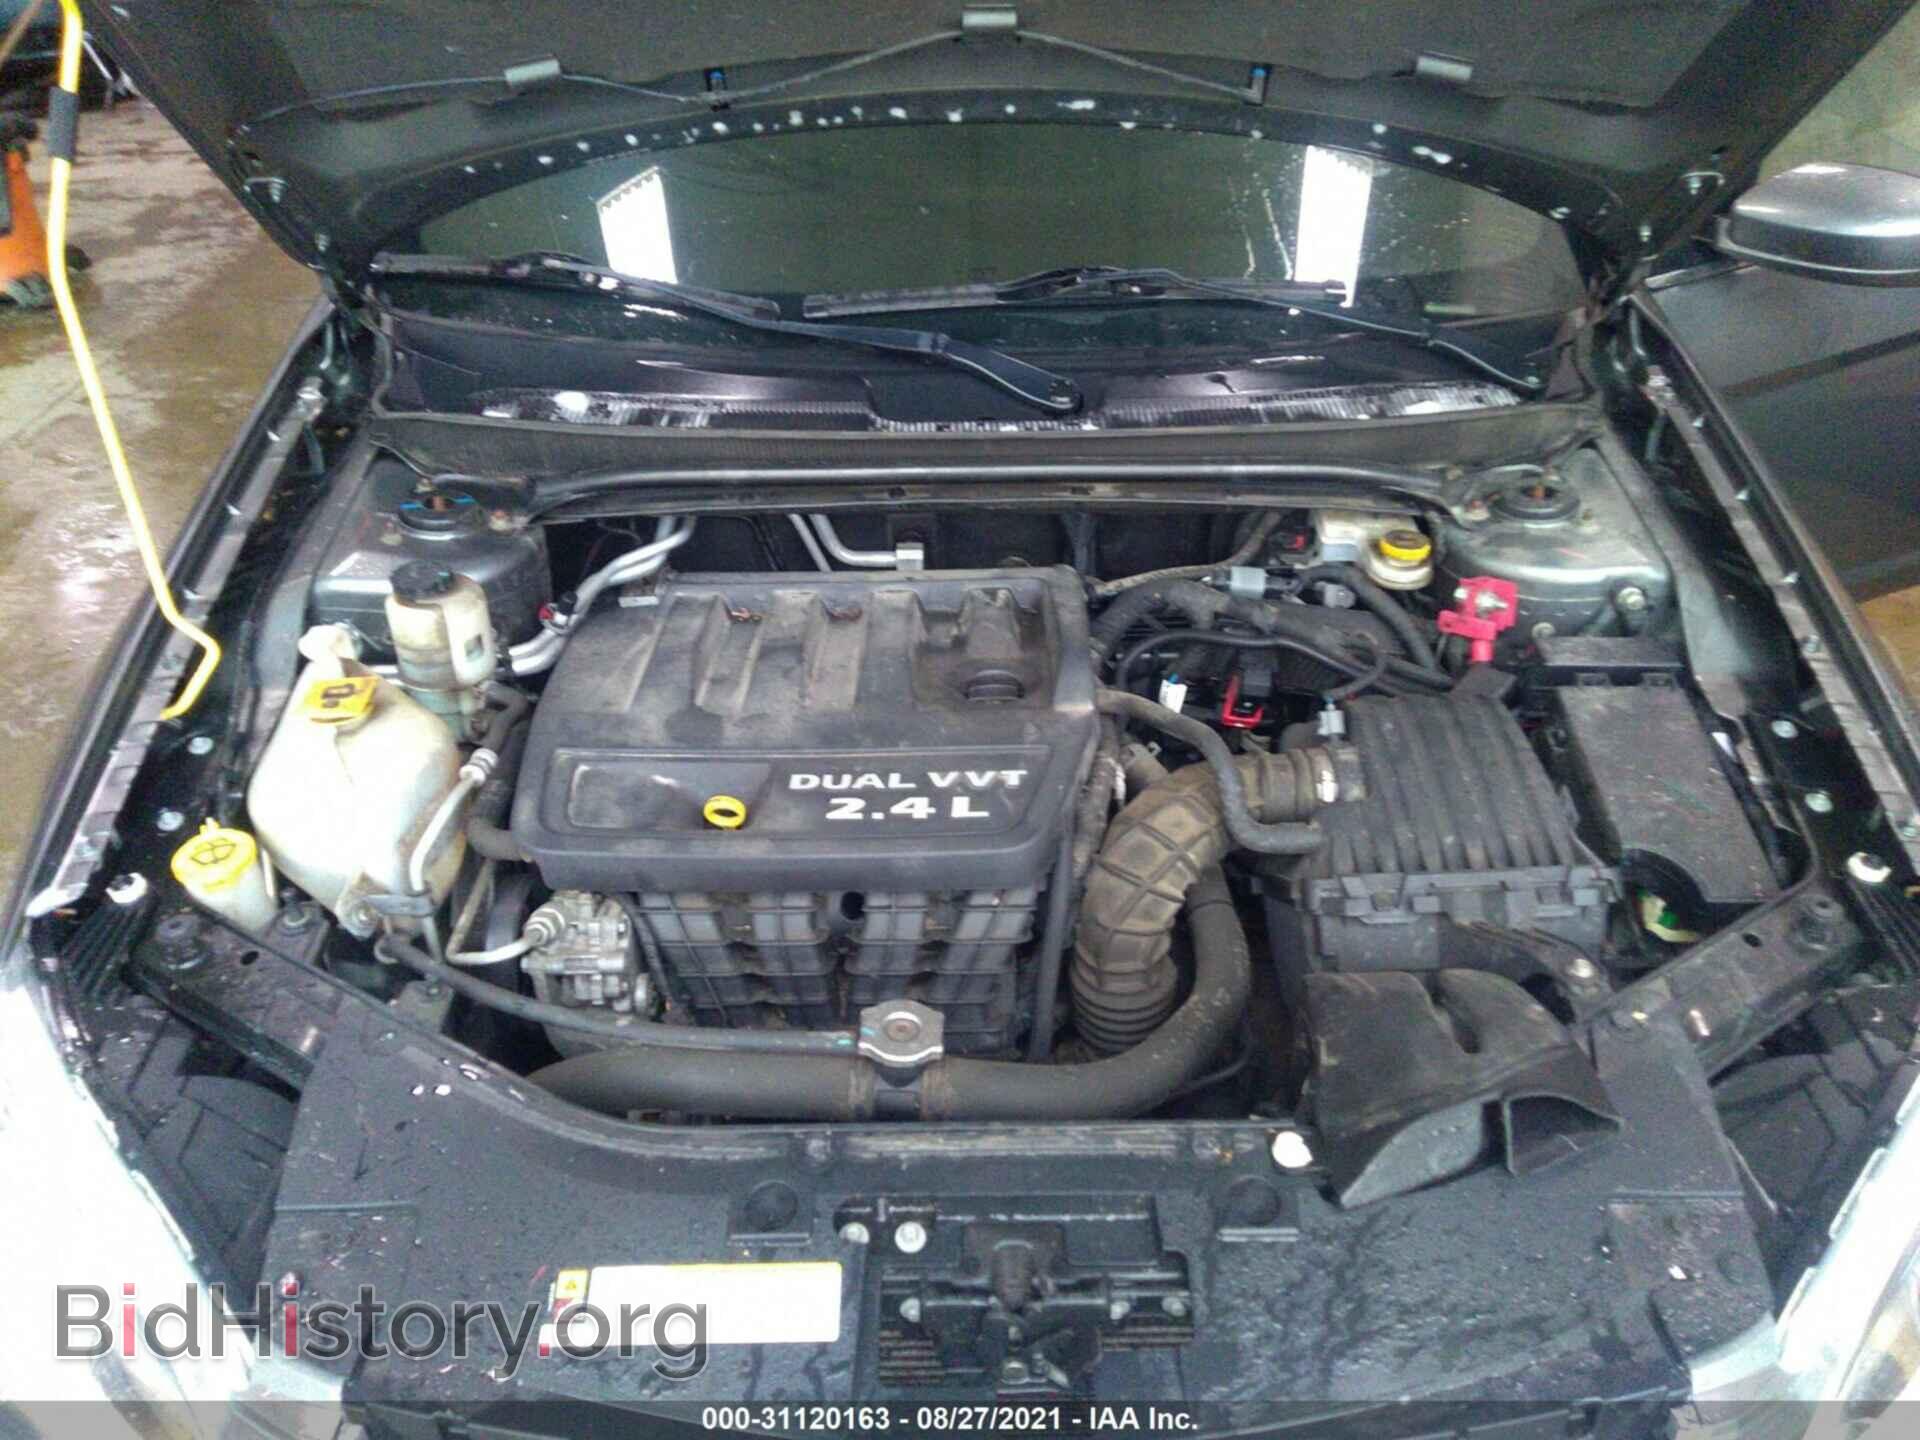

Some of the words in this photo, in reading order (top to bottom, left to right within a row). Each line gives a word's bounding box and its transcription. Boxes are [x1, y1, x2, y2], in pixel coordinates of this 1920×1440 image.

[789, 772, 916, 790] DUAL
[927, 770, 1028, 788] VVT
[825, 796, 936, 819] 2.4
[951, 796, 990, 818] L
